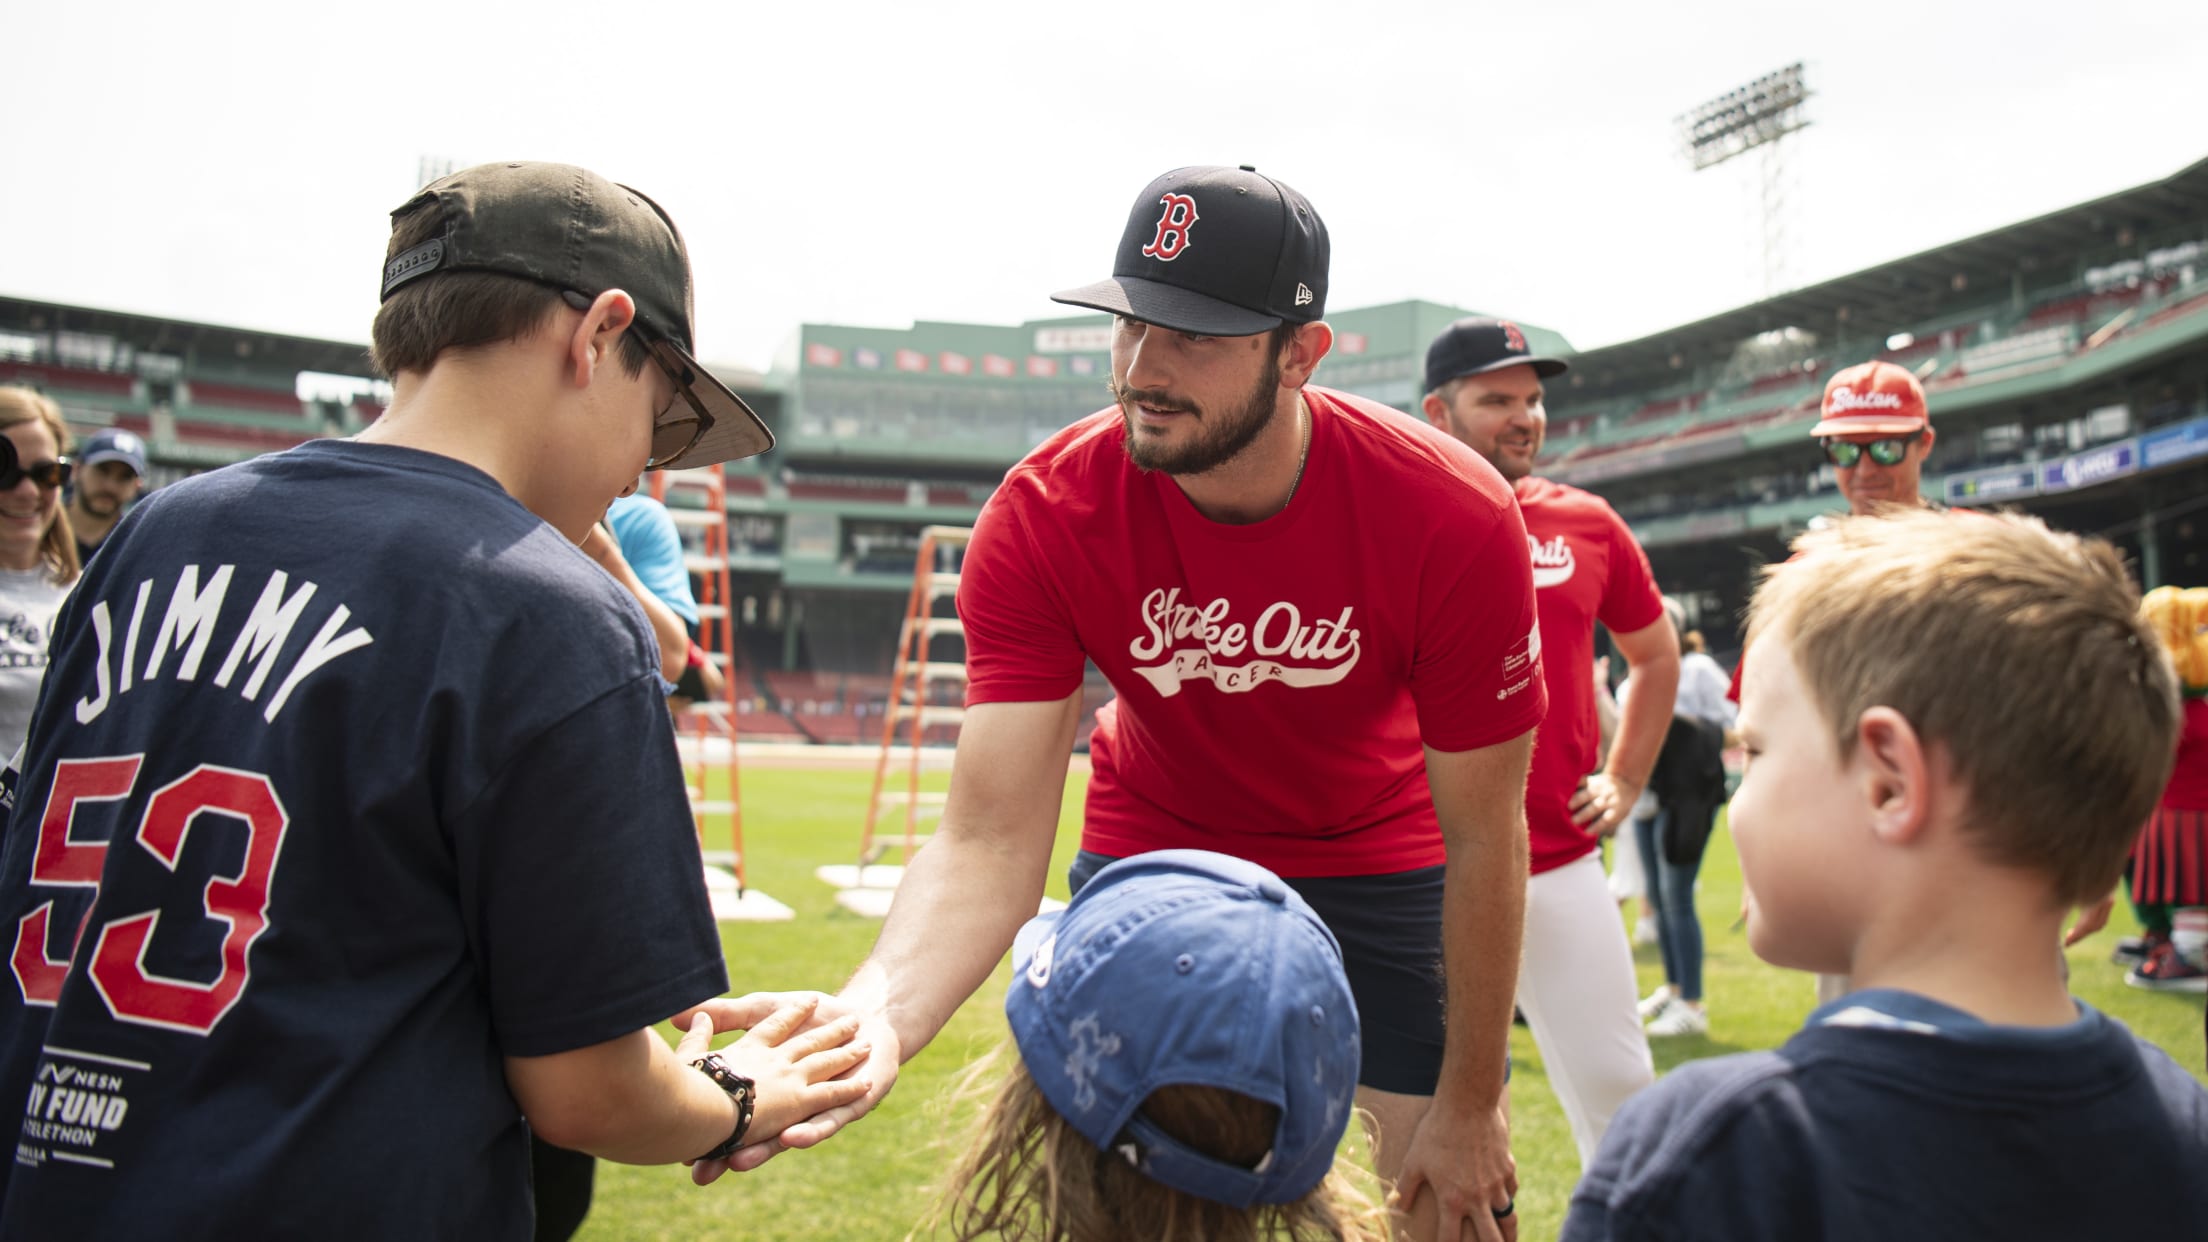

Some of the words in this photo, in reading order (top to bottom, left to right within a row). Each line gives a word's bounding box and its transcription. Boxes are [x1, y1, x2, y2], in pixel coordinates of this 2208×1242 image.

[1142, 192, 1200, 262] B
[1829, 386, 1903, 414] Boston
[75, 564, 375, 725] JIMMY
[1253, 601, 1359, 660] Out
[1174, 655, 1283, 688] CACER
[9, 752, 291, 1037] 53
[73, 1069, 123, 1093] NESN
[45, 1086, 129, 1131] FUND
